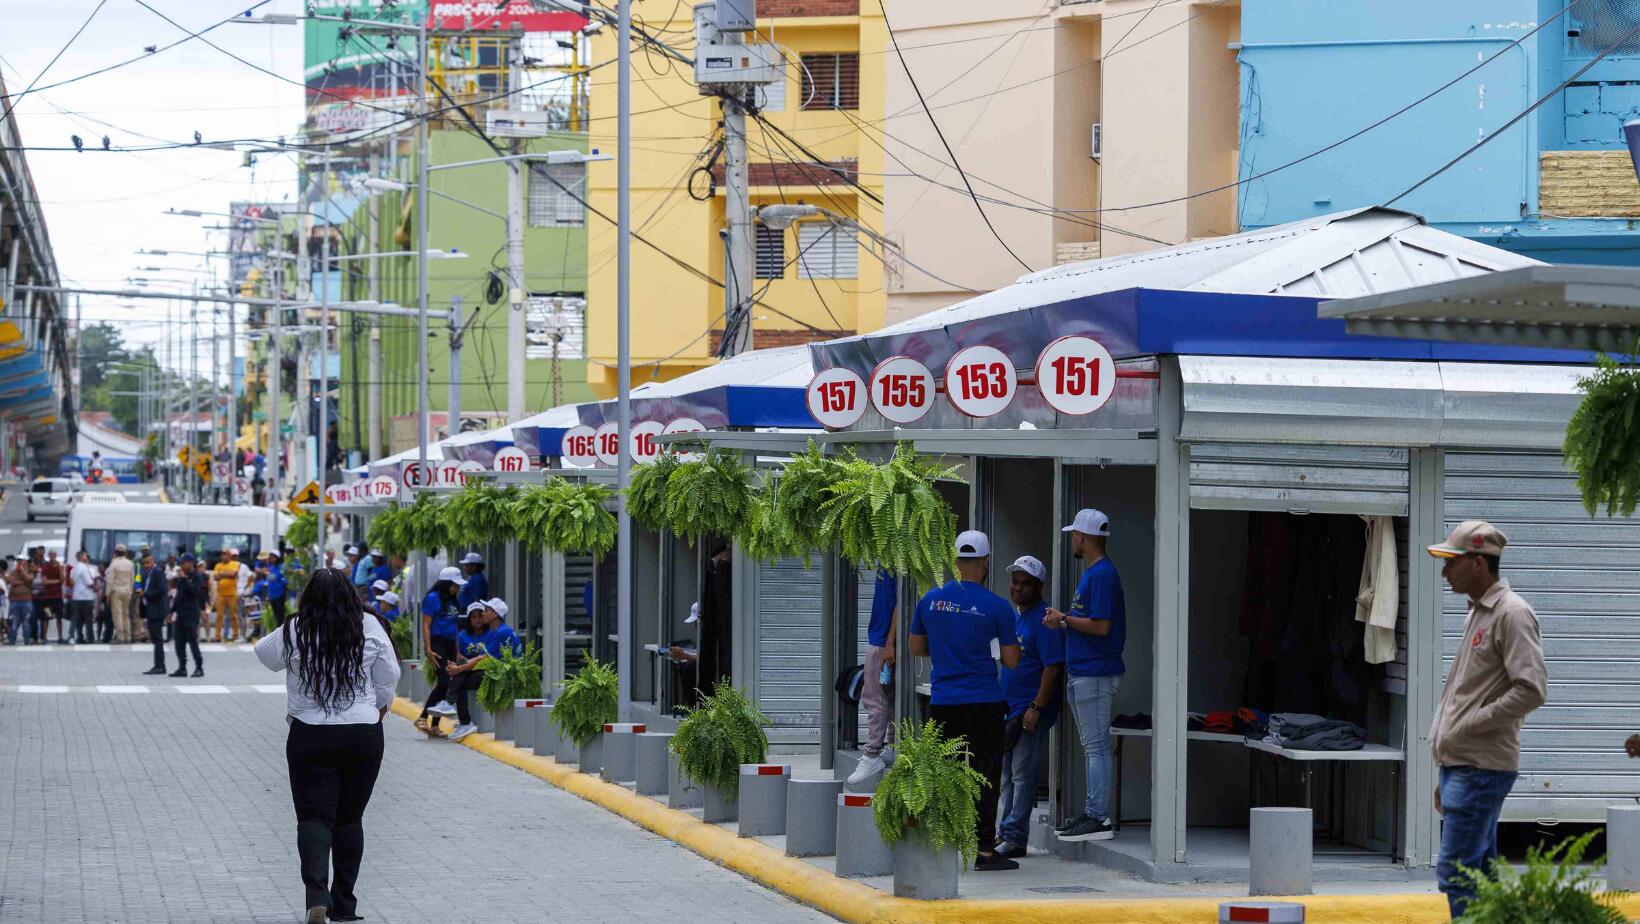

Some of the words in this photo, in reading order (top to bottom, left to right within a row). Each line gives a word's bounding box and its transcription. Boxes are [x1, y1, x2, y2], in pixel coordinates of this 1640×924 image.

[955, 362, 1008, 400] 153
[1051, 356, 1101, 396] 151
[817, 380, 856, 412] 157
[879, 374, 925, 407] 155
[567, 435, 597, 457] 165
[600, 433, 619, 455] 16
[499, 456, 523, 471] 167
[443, 467, 456, 483] 17
[375, 481, 392, 496] 175
